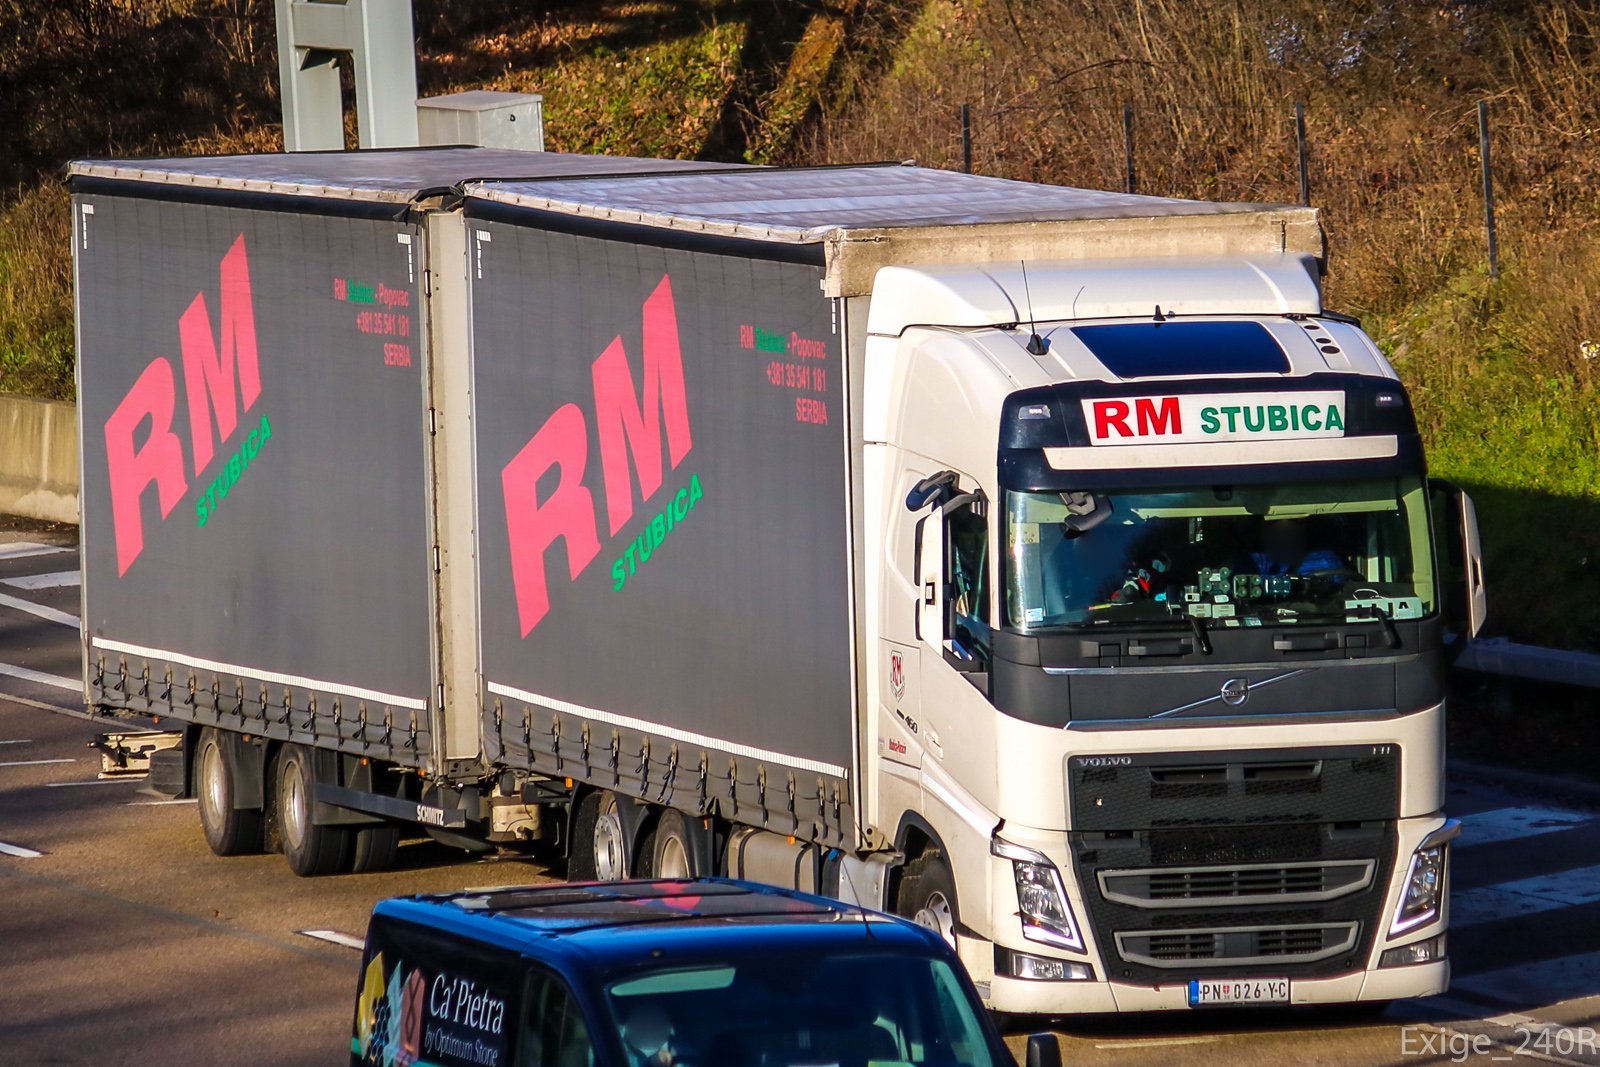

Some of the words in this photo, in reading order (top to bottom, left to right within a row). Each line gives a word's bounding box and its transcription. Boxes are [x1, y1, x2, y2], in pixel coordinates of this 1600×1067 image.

[334, 278, 346, 300] RM
[384, 343, 411, 367] SERBIA
[740, 325, 754, 349] RM
[792, 331, 826, 362] Popovac
[767, 361, 784, 386] +381
[786, 363, 795, 388] 35
[797, 365, 810, 390] 541
[813, 367, 826, 392] 181
[104, 232, 262, 578] RM
[796, 397, 828, 425] SERBIA
[1093, 397, 1182, 439] RM
[1200, 404, 1345, 434] STUBICA
[195, 414, 272, 527] STUBICA
[501, 273, 693, 640] RM
[611, 473, 704, 592] STUBICA
[1076, 756, 1132, 767] VOLVO
[416, 804, 444, 826] SCHMITZ
[424, 1024, 434, 1054] by
[434, 1027, 474, 1062] Optimum
[474, 1038, 498, 1067] Stone
